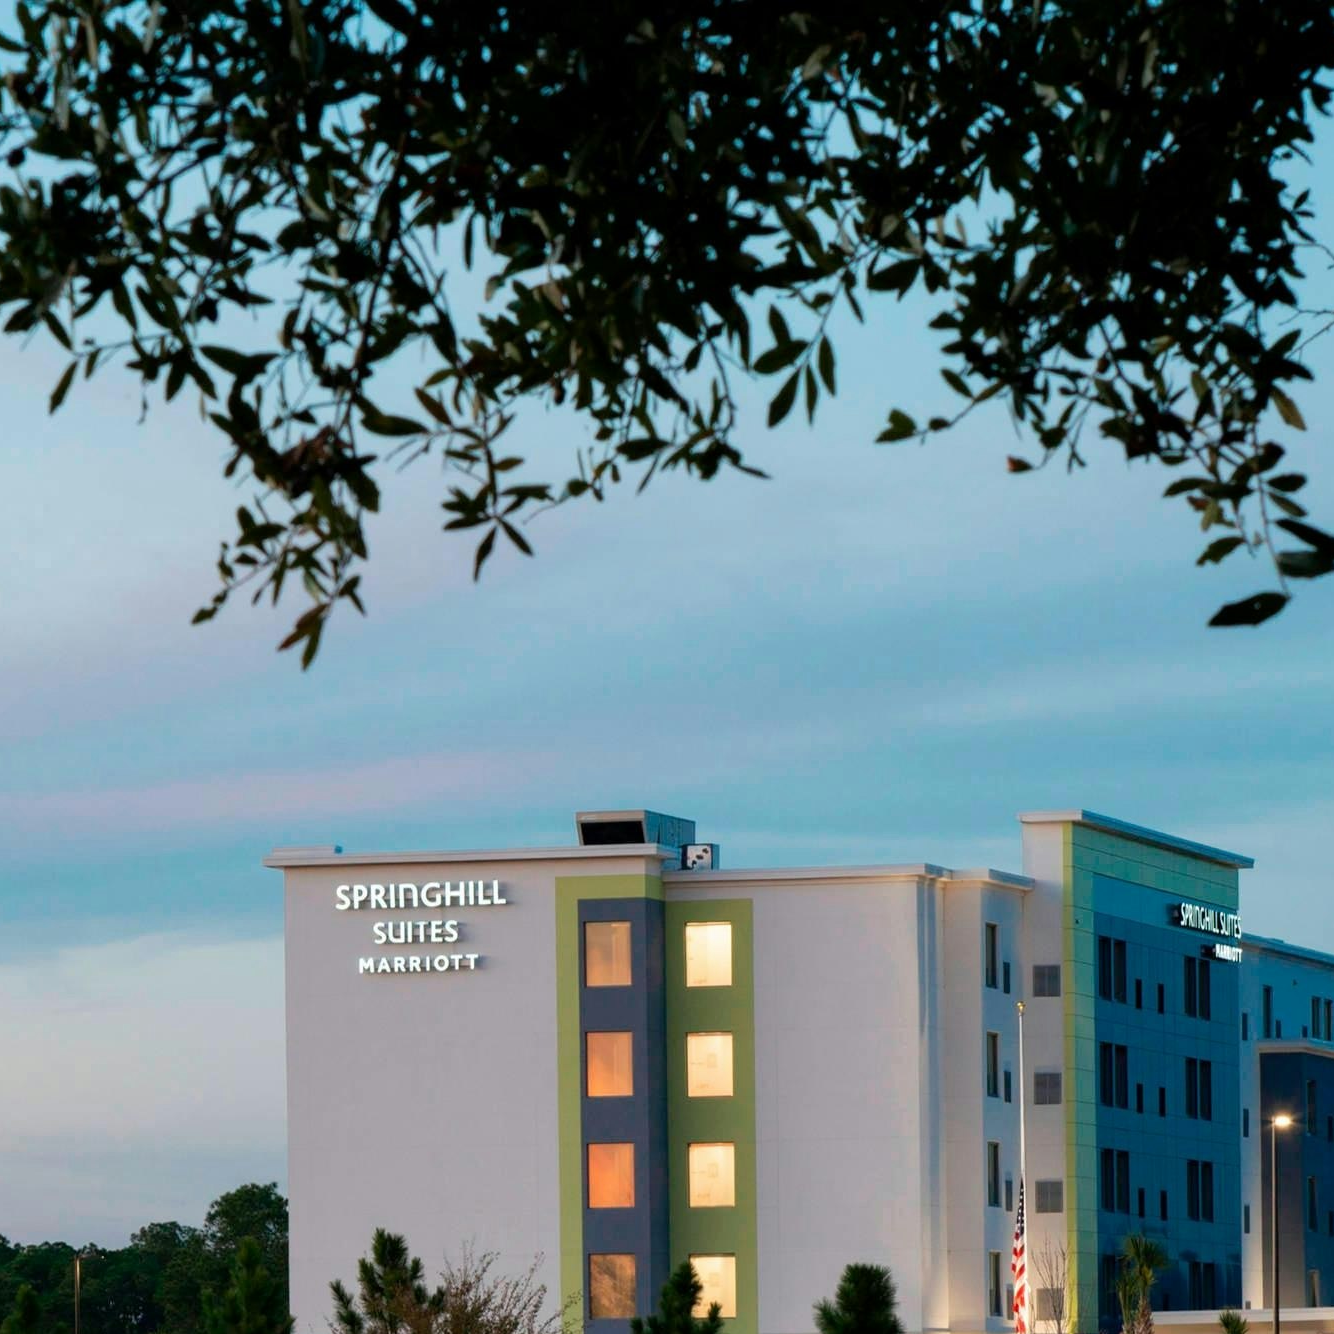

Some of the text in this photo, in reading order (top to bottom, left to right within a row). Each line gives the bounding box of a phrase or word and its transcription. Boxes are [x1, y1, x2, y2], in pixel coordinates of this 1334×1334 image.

[335, 879, 507, 910] SPRINGHILL
[1180, 902, 1220, 934] SPRINGHILL
[373, 920, 459, 944] SUITES
[358, 954, 479, 974] MARRIOTT
